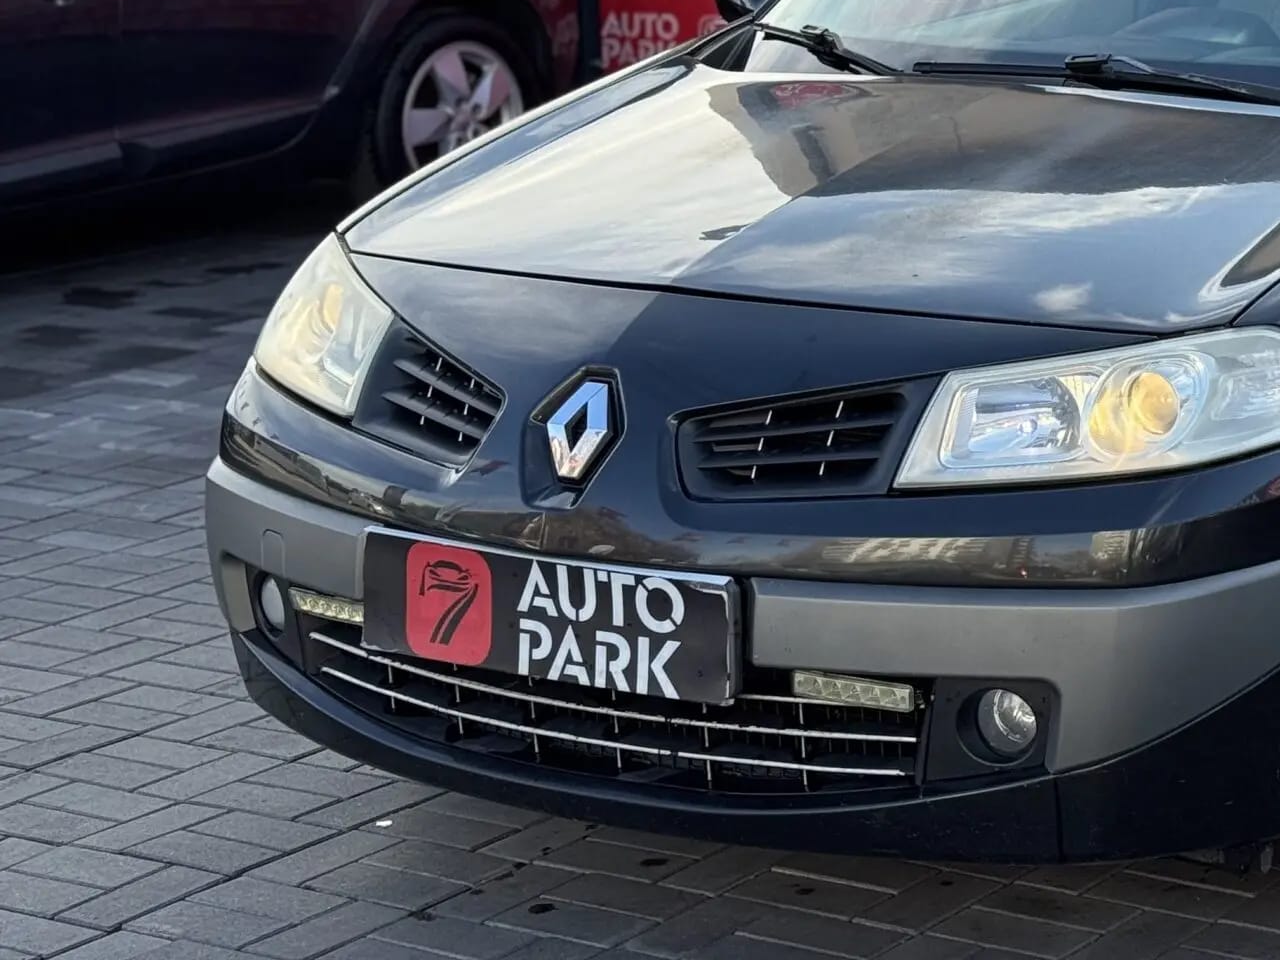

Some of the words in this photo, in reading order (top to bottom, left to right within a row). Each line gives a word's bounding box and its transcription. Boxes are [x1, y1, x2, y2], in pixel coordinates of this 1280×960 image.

[602, 12, 680, 41] AUTO
[516, 559, 686, 635] AUTO
[518, 618, 682, 701] PARK
